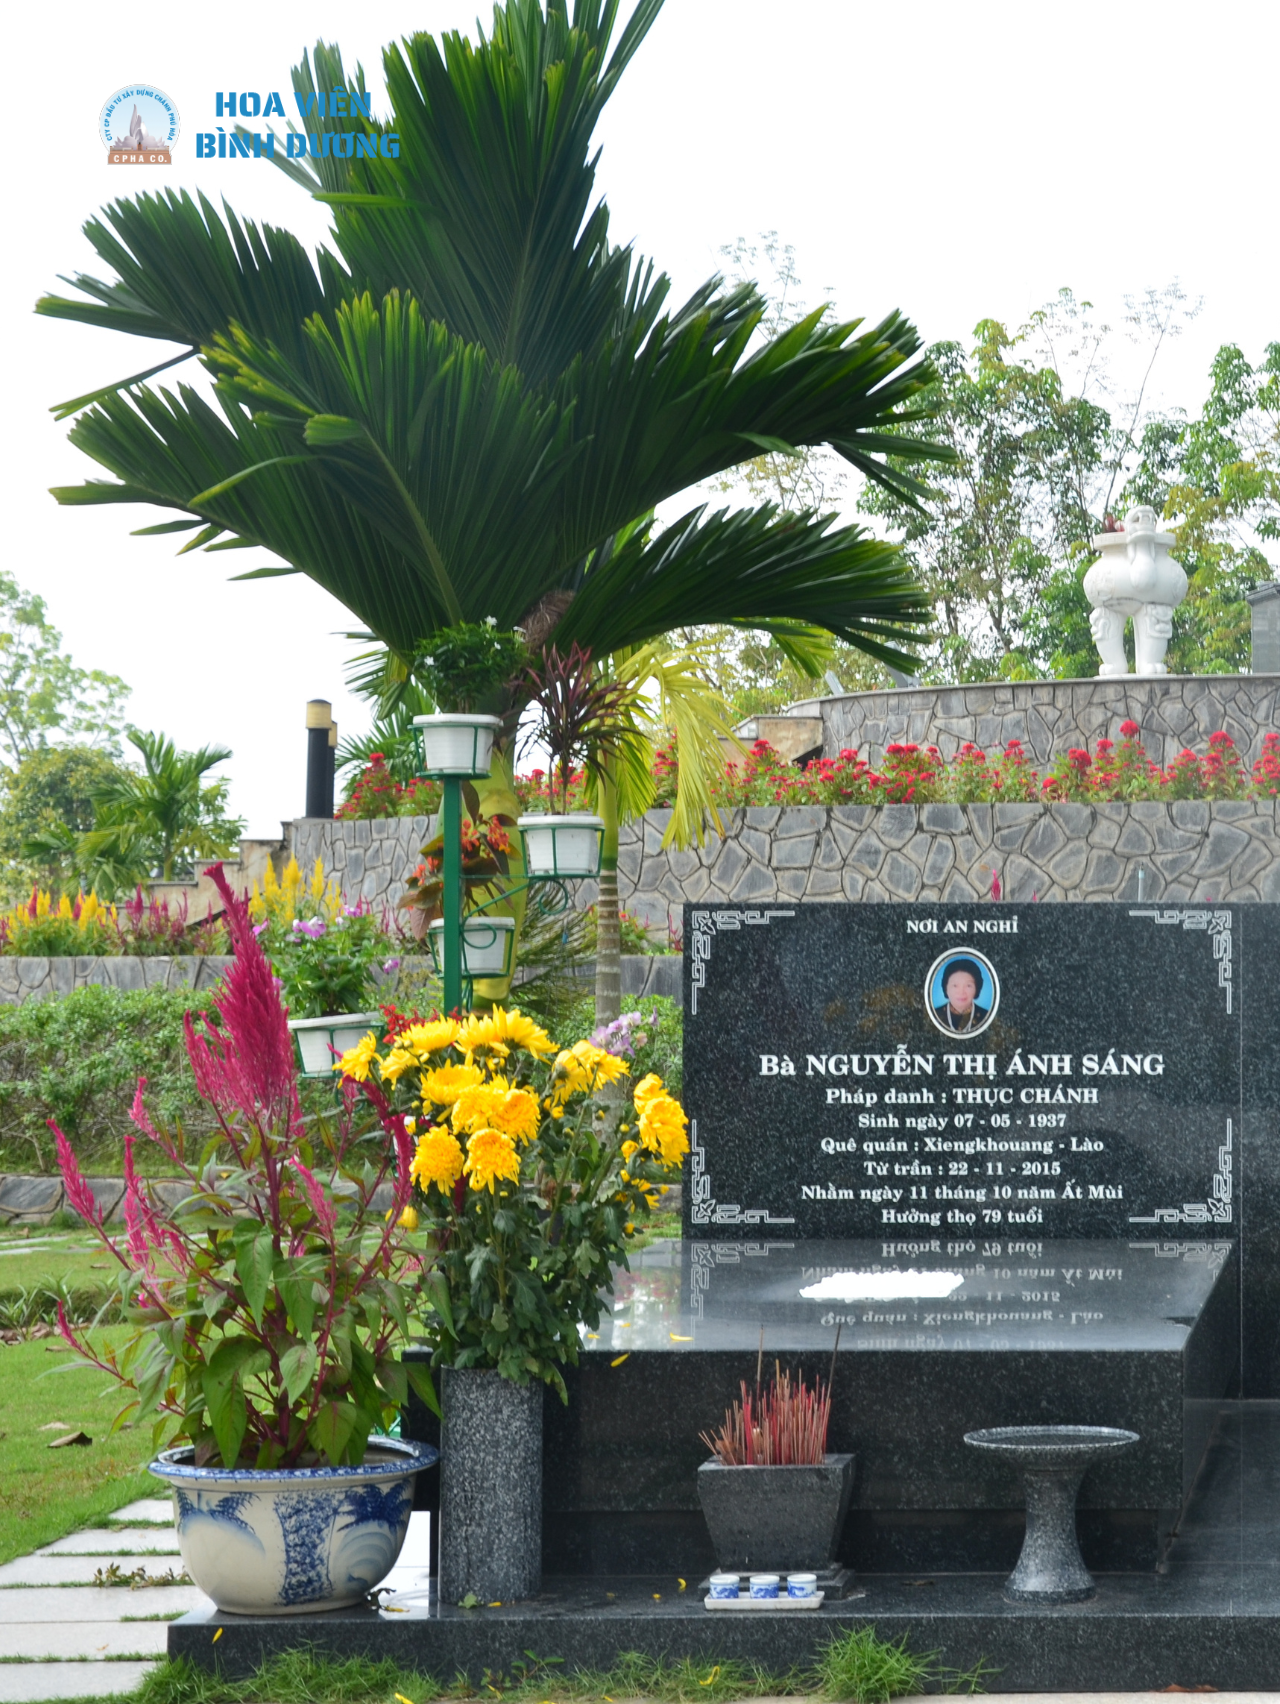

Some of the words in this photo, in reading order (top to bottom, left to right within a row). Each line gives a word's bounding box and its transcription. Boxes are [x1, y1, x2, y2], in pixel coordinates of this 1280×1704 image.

[906, 918, 939, 934] NƠI
[942, 919, 969, 934] AN
[973, 914, 1019, 934] NGHỈ
[758, 1054, 797, 1076] Bà
[805, 1043, 935, 1076] NGUYỄN
[942, 1053, 998, 1081] THỊ
[1005, 1047, 1073, 1076] ÁNH
[1081, 1047, 1166, 1076] SÁNG
[825, 1087, 878, 1108] Pháp
[883, 1087, 935, 1104] danh
[952, 1087, 1014, 1108] THỤC
[1019, 1084, 1099, 1104] CHÁNH
[858, 1112, 900, 1129] Sinh
[905, 1113, 949, 1131] ngày
[953, 1113, 975, 1128] 07
[990, 1113, 1011, 1128] 05
[1028, 1112, 1067, 1128] 1937
[820, 1136, 857, 1155] Quê
[862, 1136, 909, 1156] quán
[923, 1136, 1054, 1155] Xiengkhouang
[1070, 1136, 1105, 1152] Lào
[863, 1160, 890, 1176] Từ
[894, 1158, 933, 1176] trần
[948, 1161, 969, 1176] 22
[986, 1161, 1004, 1176] 11
[1021, 1160, 1061, 1176] 2015
[801, 1182, 855, 1200] Nhằm
[859, 1185, 904, 1203] ngày
[909, 1185, 928, 1200] 11
[934, 1184, 987, 1203] tháng
[993, 1185, 1012, 1200] 10
[1017, 1185, 1057, 1200] năm
[1060, 1180, 1083, 1200] Ất
[1088, 1184, 1124, 1200] Mùi
[881, 1208, 942, 1227] Hưởng
[946, 1208, 977, 1227] thọ
[981, 1209, 1002, 1224] 79
[1007, 1206, 1044, 1224] tuổi
